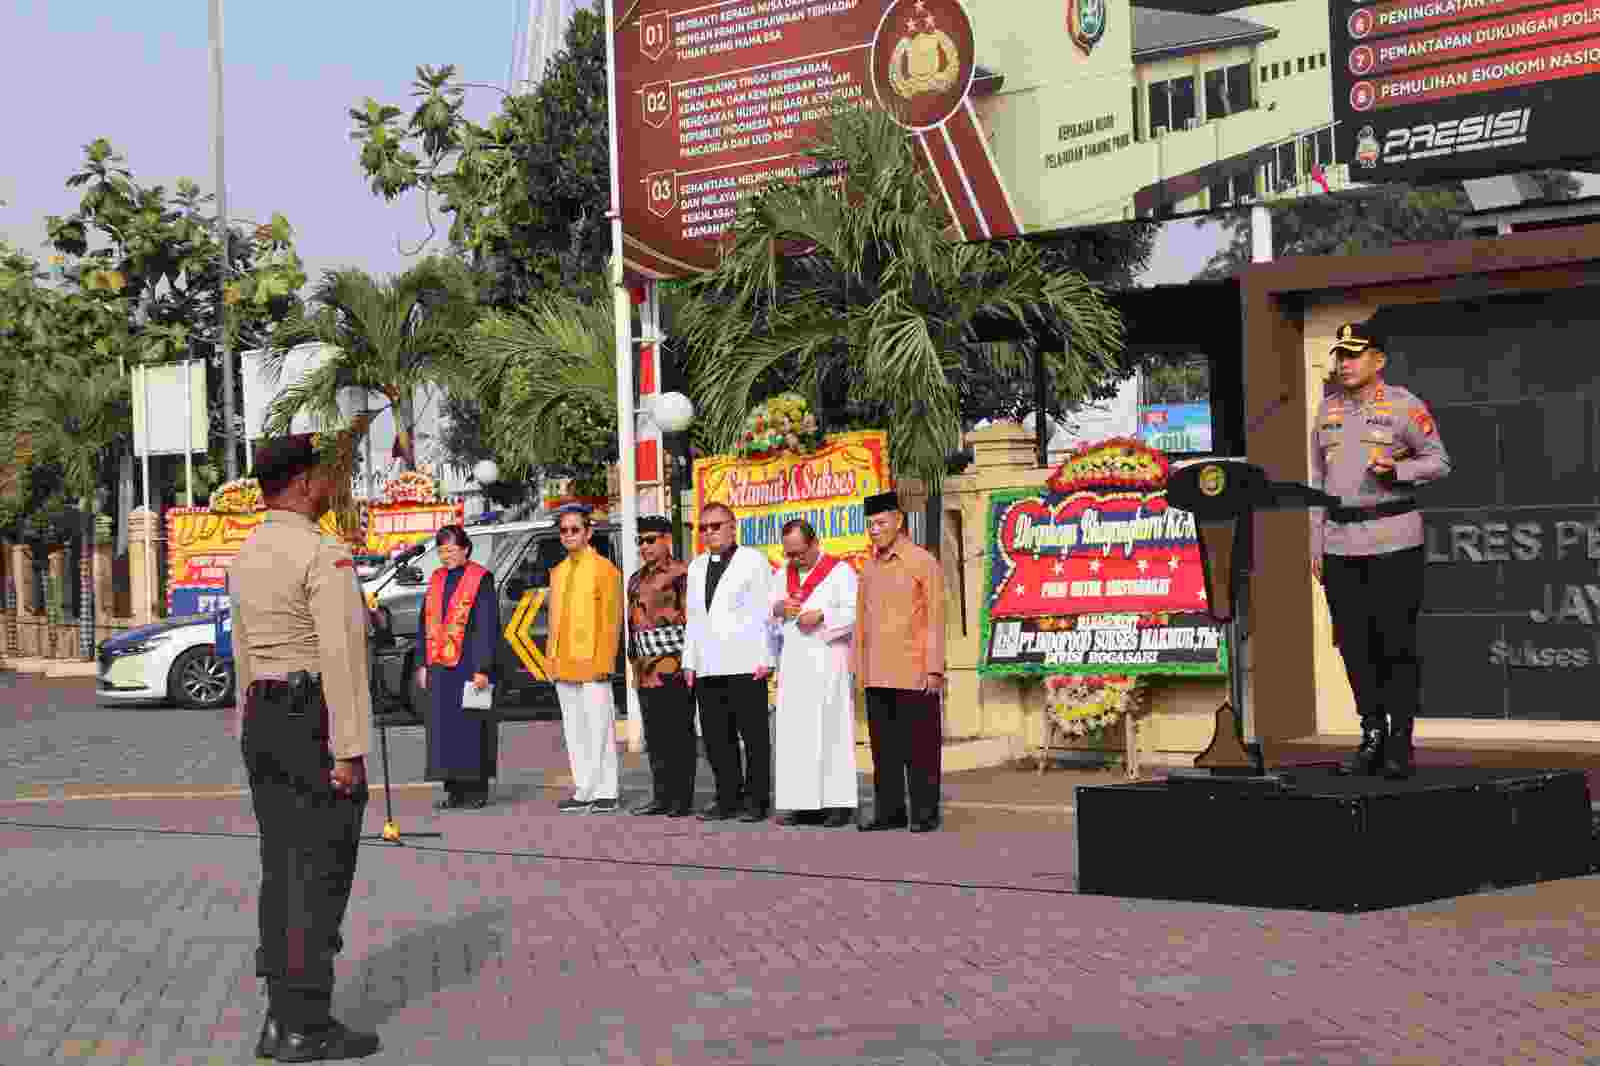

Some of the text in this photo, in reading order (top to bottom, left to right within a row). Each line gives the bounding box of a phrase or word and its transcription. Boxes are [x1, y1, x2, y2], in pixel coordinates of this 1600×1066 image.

[1379, 0, 1485, 25] PENINGKATAN
[646, 24, 664, 46] 01
[1356, 54, 1364, 68] 7
[1380, 33, 1472, 62] PEMANTAPAN
[1475, 17, 1558, 43] DUKUNGAN
[1356, 89, 1366, 104] 8
[1381, 71, 1467, 98] PEMULIHAN
[1472, 57, 1545, 82] EKONOMI
[647, 91, 666, 112] 02
[1383, 107, 1531, 157] PRESISI
[652, 181, 671, 201] 03
[1426, 520, 1544, 562] LRES
